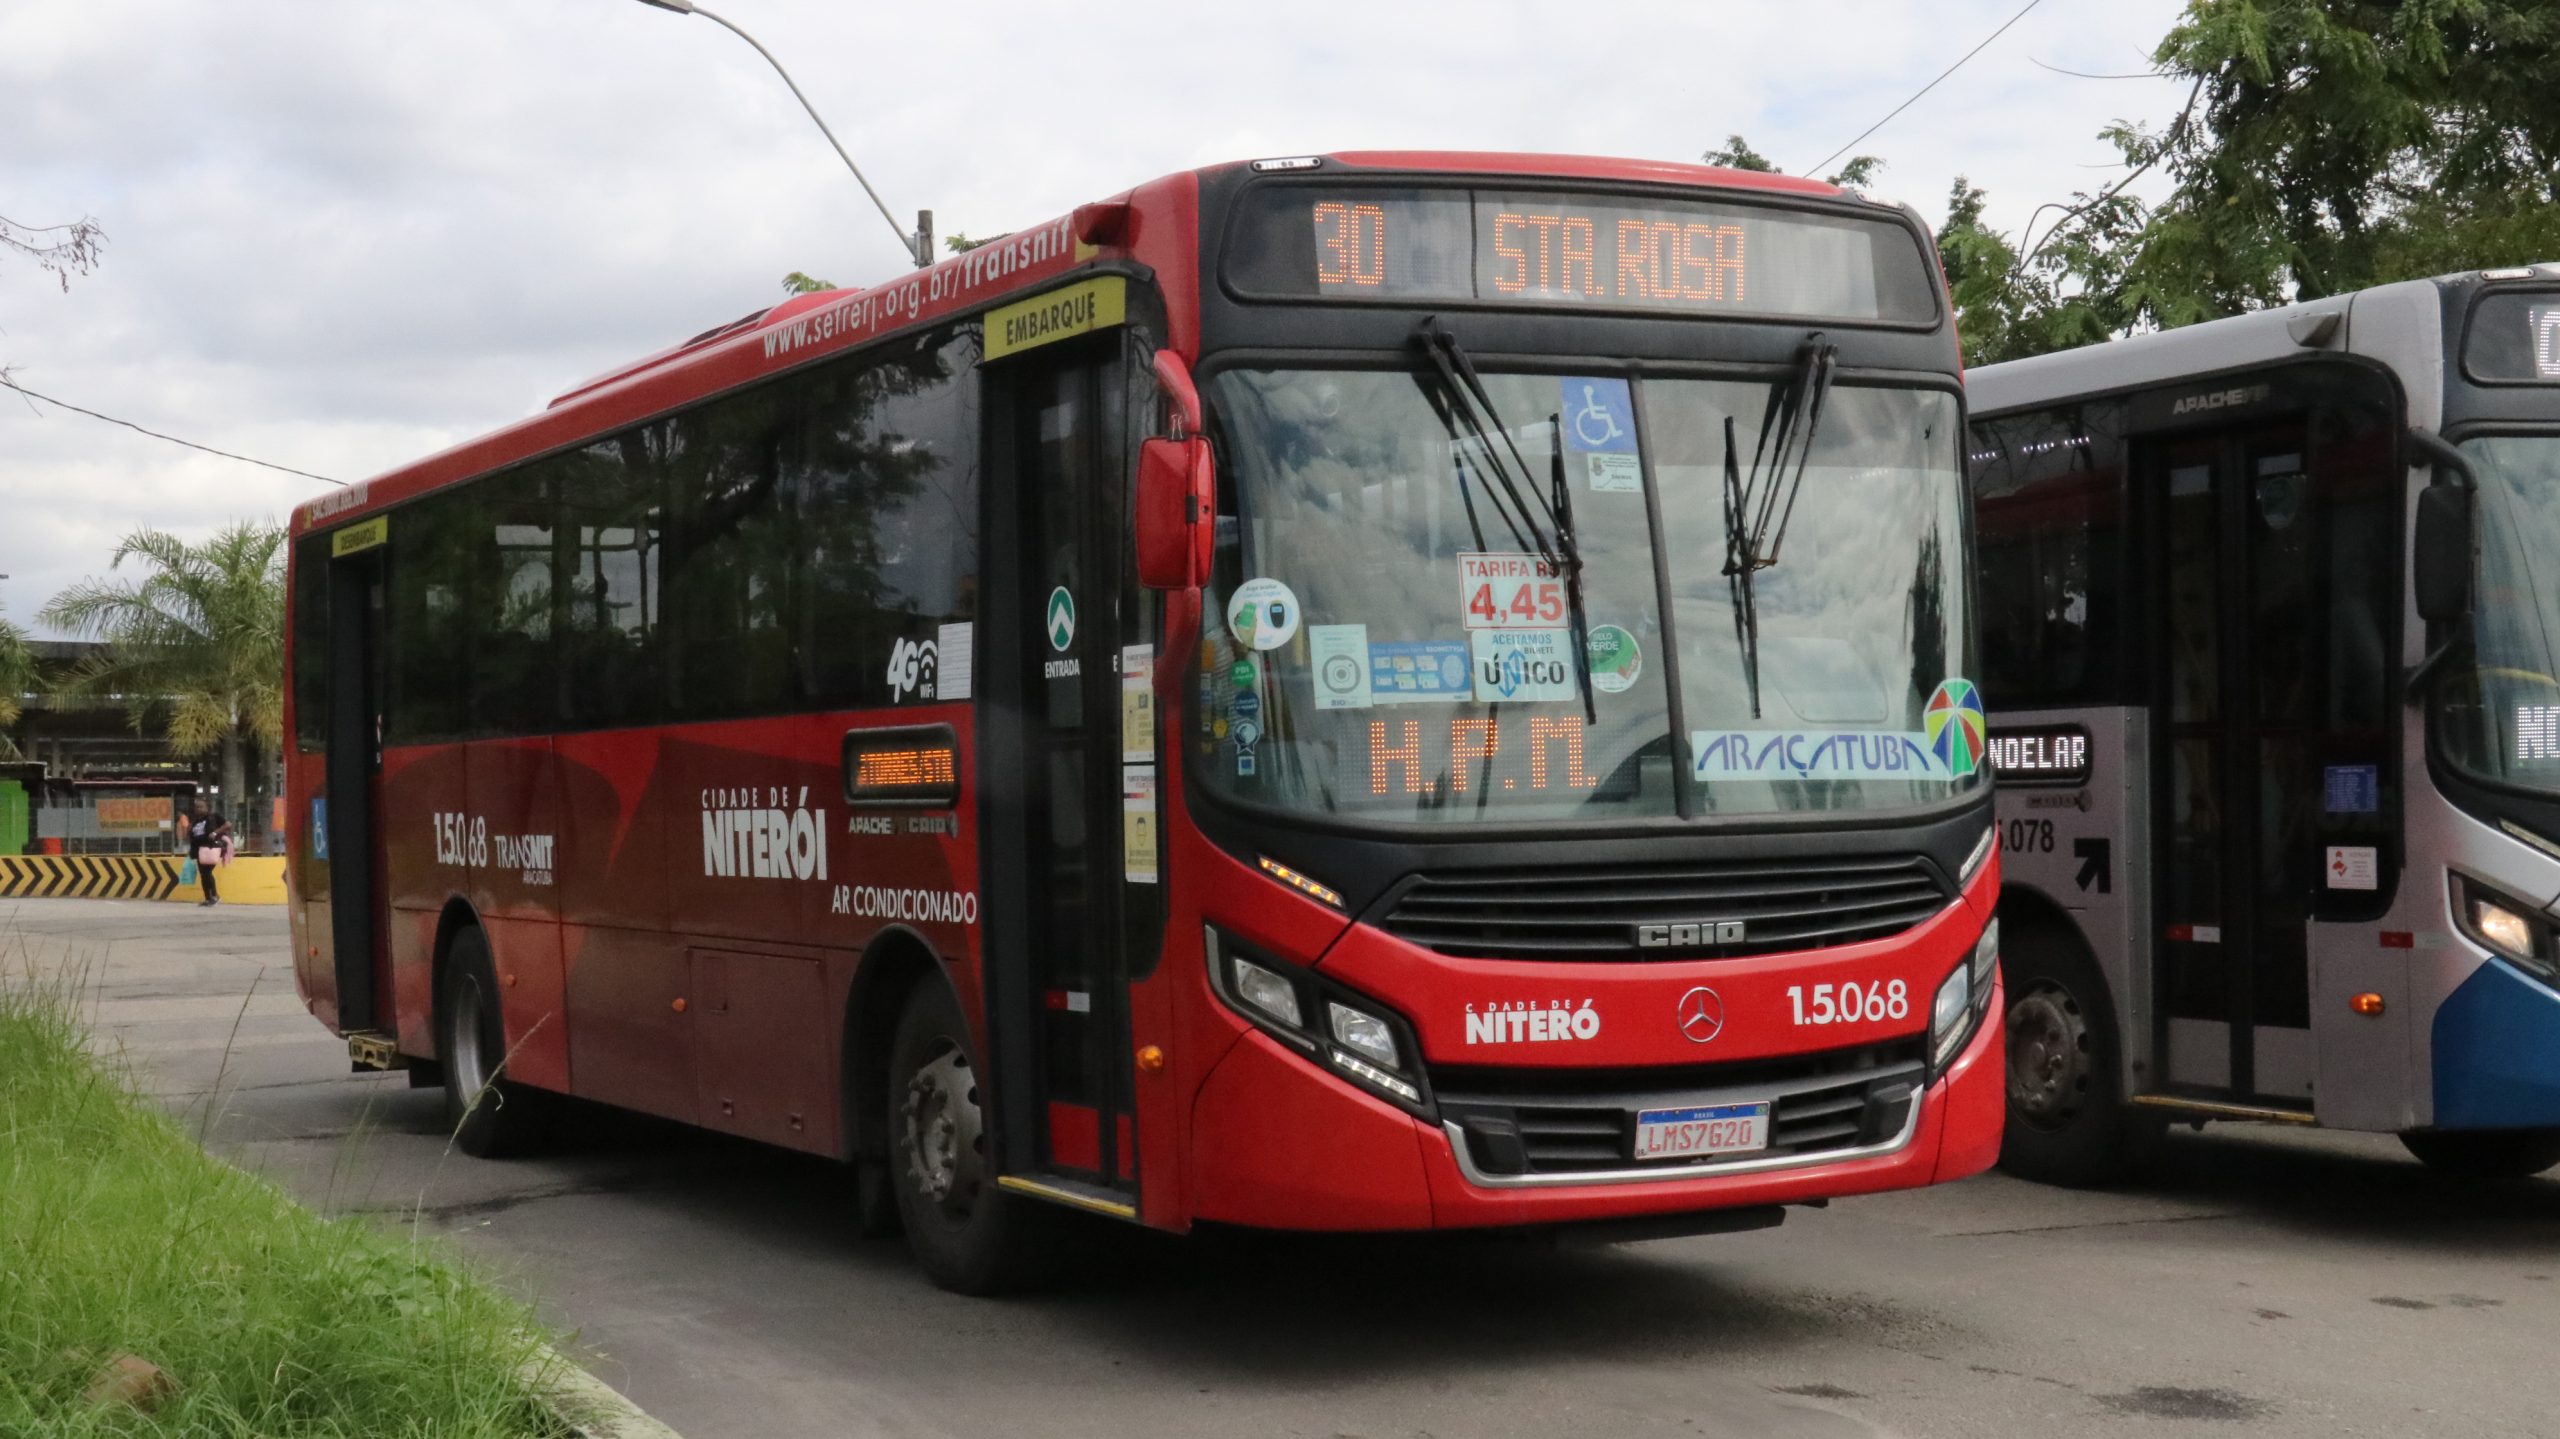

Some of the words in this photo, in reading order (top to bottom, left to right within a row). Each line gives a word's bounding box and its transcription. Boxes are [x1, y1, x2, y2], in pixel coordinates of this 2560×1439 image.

[1314, 202, 1384, 285] 30
[1494, 213, 1605, 295] STA.
[1617, 219, 1744, 300] ROSA
[1005, 291, 1096, 347] EMBARQUE
[2173, 388, 2246, 414] APACHE
[1466, 561, 1530, 577] TARIFA
[1470, 583, 1563, 624] 4,45
[1492, 634, 1552, 646] ACEITAMOS
[1524, 646, 1554, 654] BILHETE
[1586, 641, 1619, 651] VERDE
[887, 637, 918, 703] 4G
[1045, 659, 1080, 679] ENTRADA
[1484, 652, 1565, 686] ÚNICO
[1696, 733, 1931, 779] ARAÇATUBA
[98, 799, 171, 820] PERIGO
[702, 788, 758, 809] CIDADE
[770, 786, 789, 808] DE
[434, 812, 488, 868] 1.5.068
[702, 786, 828, 881] NITERÓI
[849, 816, 892, 835] APACHE
[494, 834, 554, 870] TRANSNIT
[832, 885, 850, 915] AR
[853, 889, 977, 925] CONDICIONADO
[1638, 921, 1745, 947] CAIO
[1552, 1000, 1570, 1010] DE
[1786, 979, 1909, 1026] 1.5.068
[1648, 1120, 1753, 1153] LMS7G20
